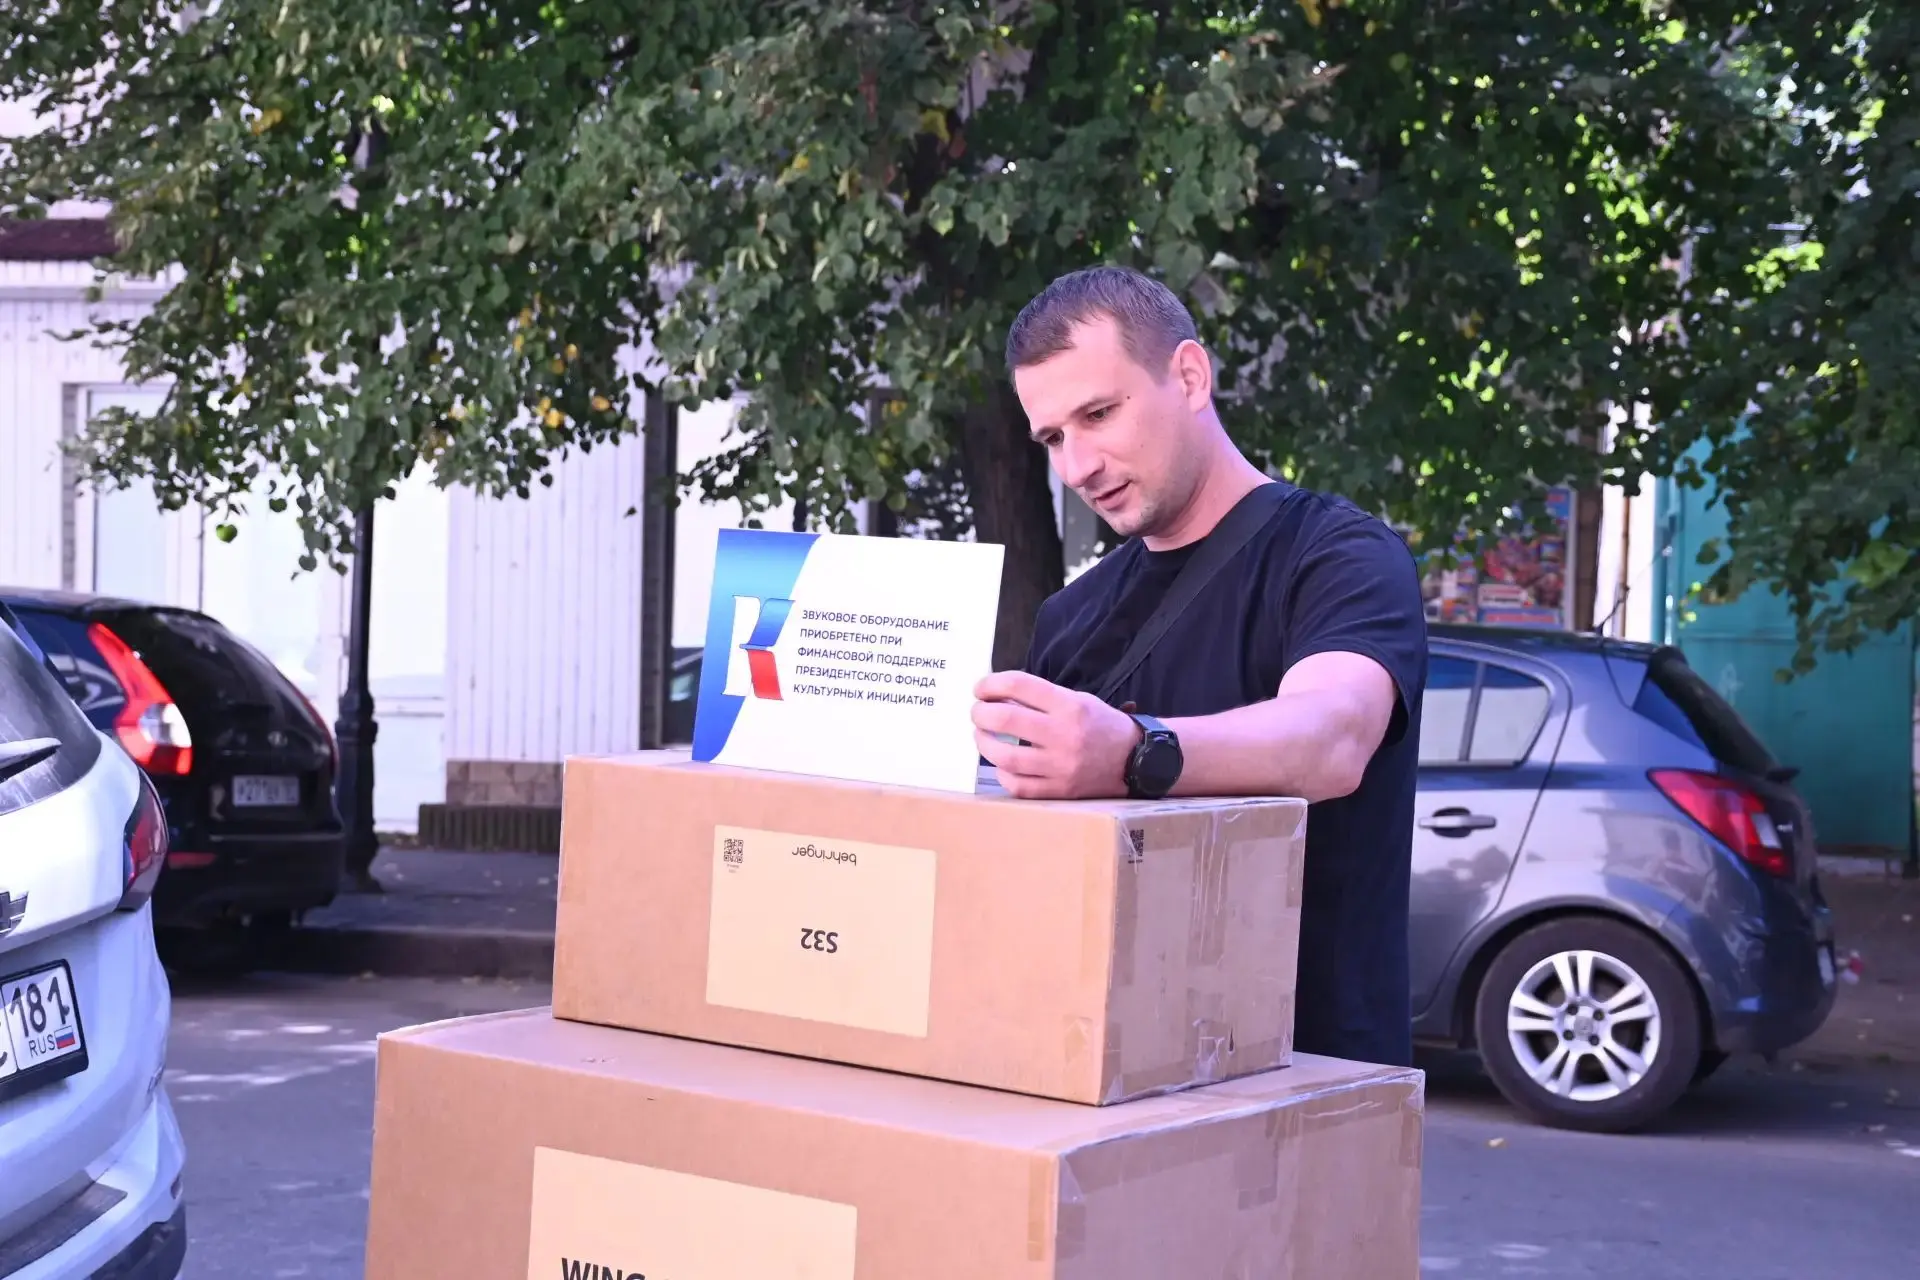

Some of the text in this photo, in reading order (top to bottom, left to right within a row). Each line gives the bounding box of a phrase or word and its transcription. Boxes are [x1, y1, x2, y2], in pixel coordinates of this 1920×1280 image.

[802, 609, 949, 631] ЗВУКОВОЕ ОБОРУДОВАНИЕ
[800, 628, 902, 646] ПРИОБРЕТЕНО ПРИ
[797, 646, 946, 669] ФИНАНСОВОЙ ПОДДЕРЖКЕ
[795, 665, 936, 688] ПРЕЗИДЕНТСКОГО ФОНДА
[793, 683, 935, 706] КУЛЬТУРНЫХ ИНИЦИАТИВ
[791, 844, 857, 866] behringer
[800, 927, 838, 953] S32
[9, 976, 70, 1038] 181
[28, 1034, 56, 1058] RUS
[561, 1257, 646, 1280] WIN
